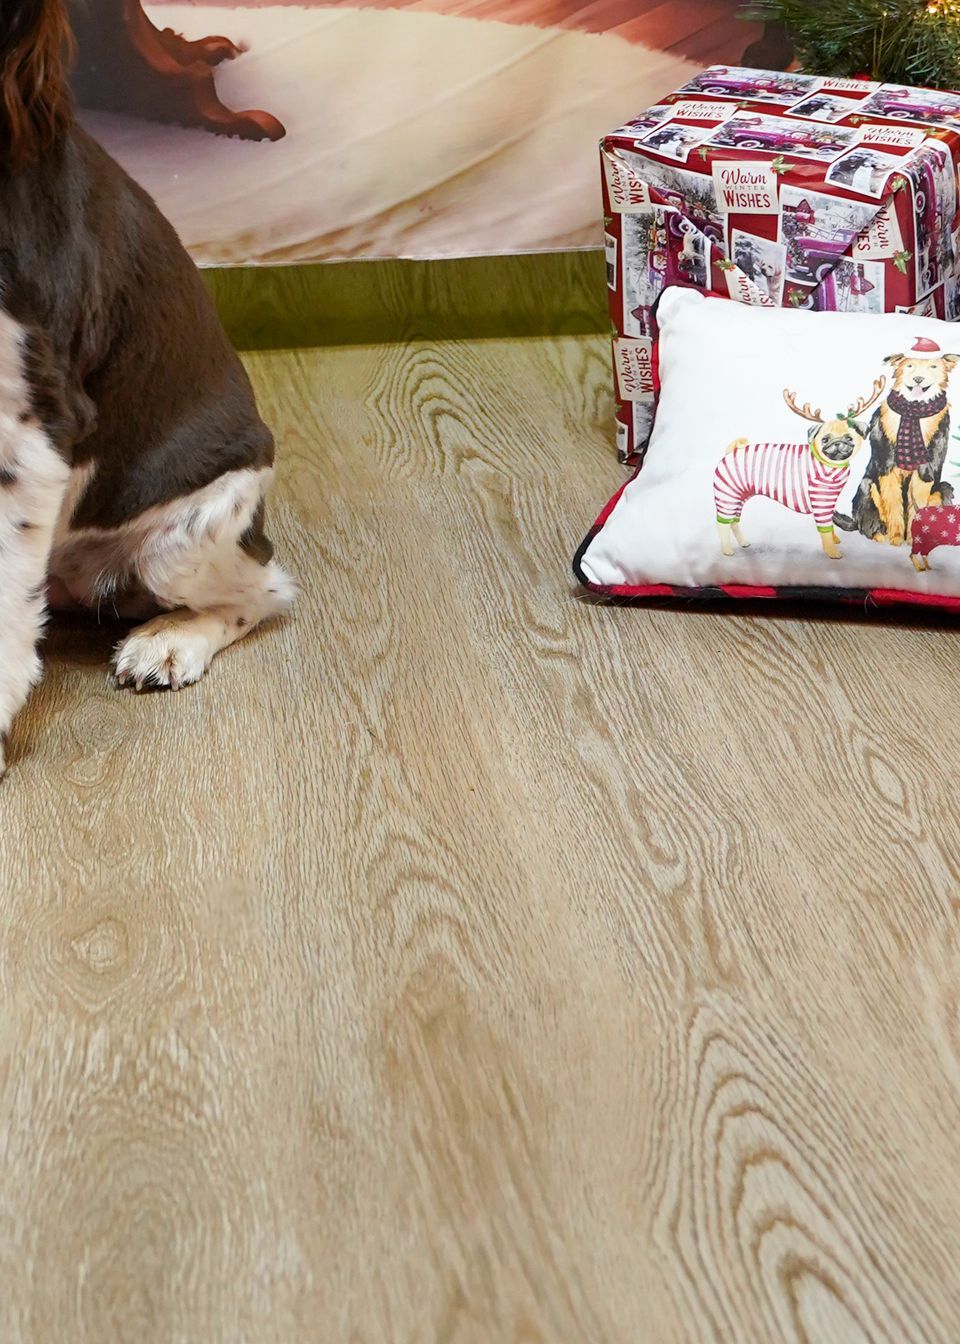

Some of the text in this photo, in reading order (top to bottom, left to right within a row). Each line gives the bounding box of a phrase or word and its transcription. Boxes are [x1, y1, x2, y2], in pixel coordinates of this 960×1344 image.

[676, 109, 723, 118] WISHES
[863, 134, 912, 145] WISHES
[721, 168, 768, 185] Warm
[723, 189, 771, 208] WISHES
[738, 276, 752, 305] arm
[621, 348, 637, 393] Warm
[635, 347, 654, 394] WISHES
